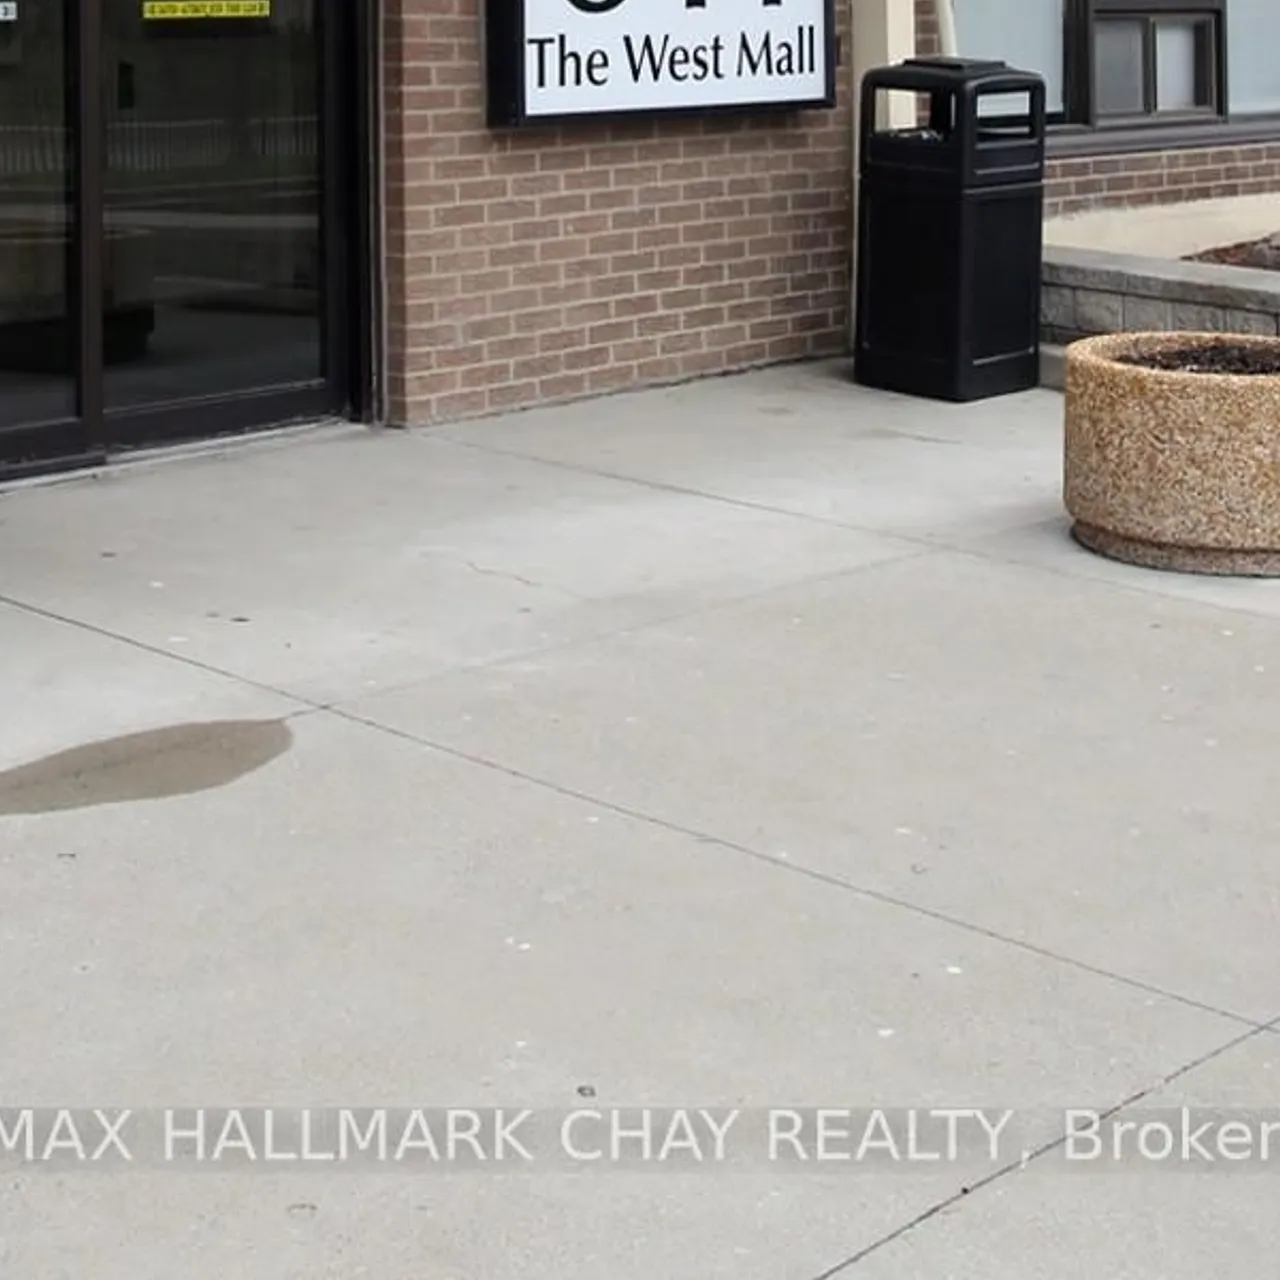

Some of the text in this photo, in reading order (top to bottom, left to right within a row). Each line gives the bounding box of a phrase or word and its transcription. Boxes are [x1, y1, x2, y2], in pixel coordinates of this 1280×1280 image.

[527, 25, 815, 88] The West Mall
